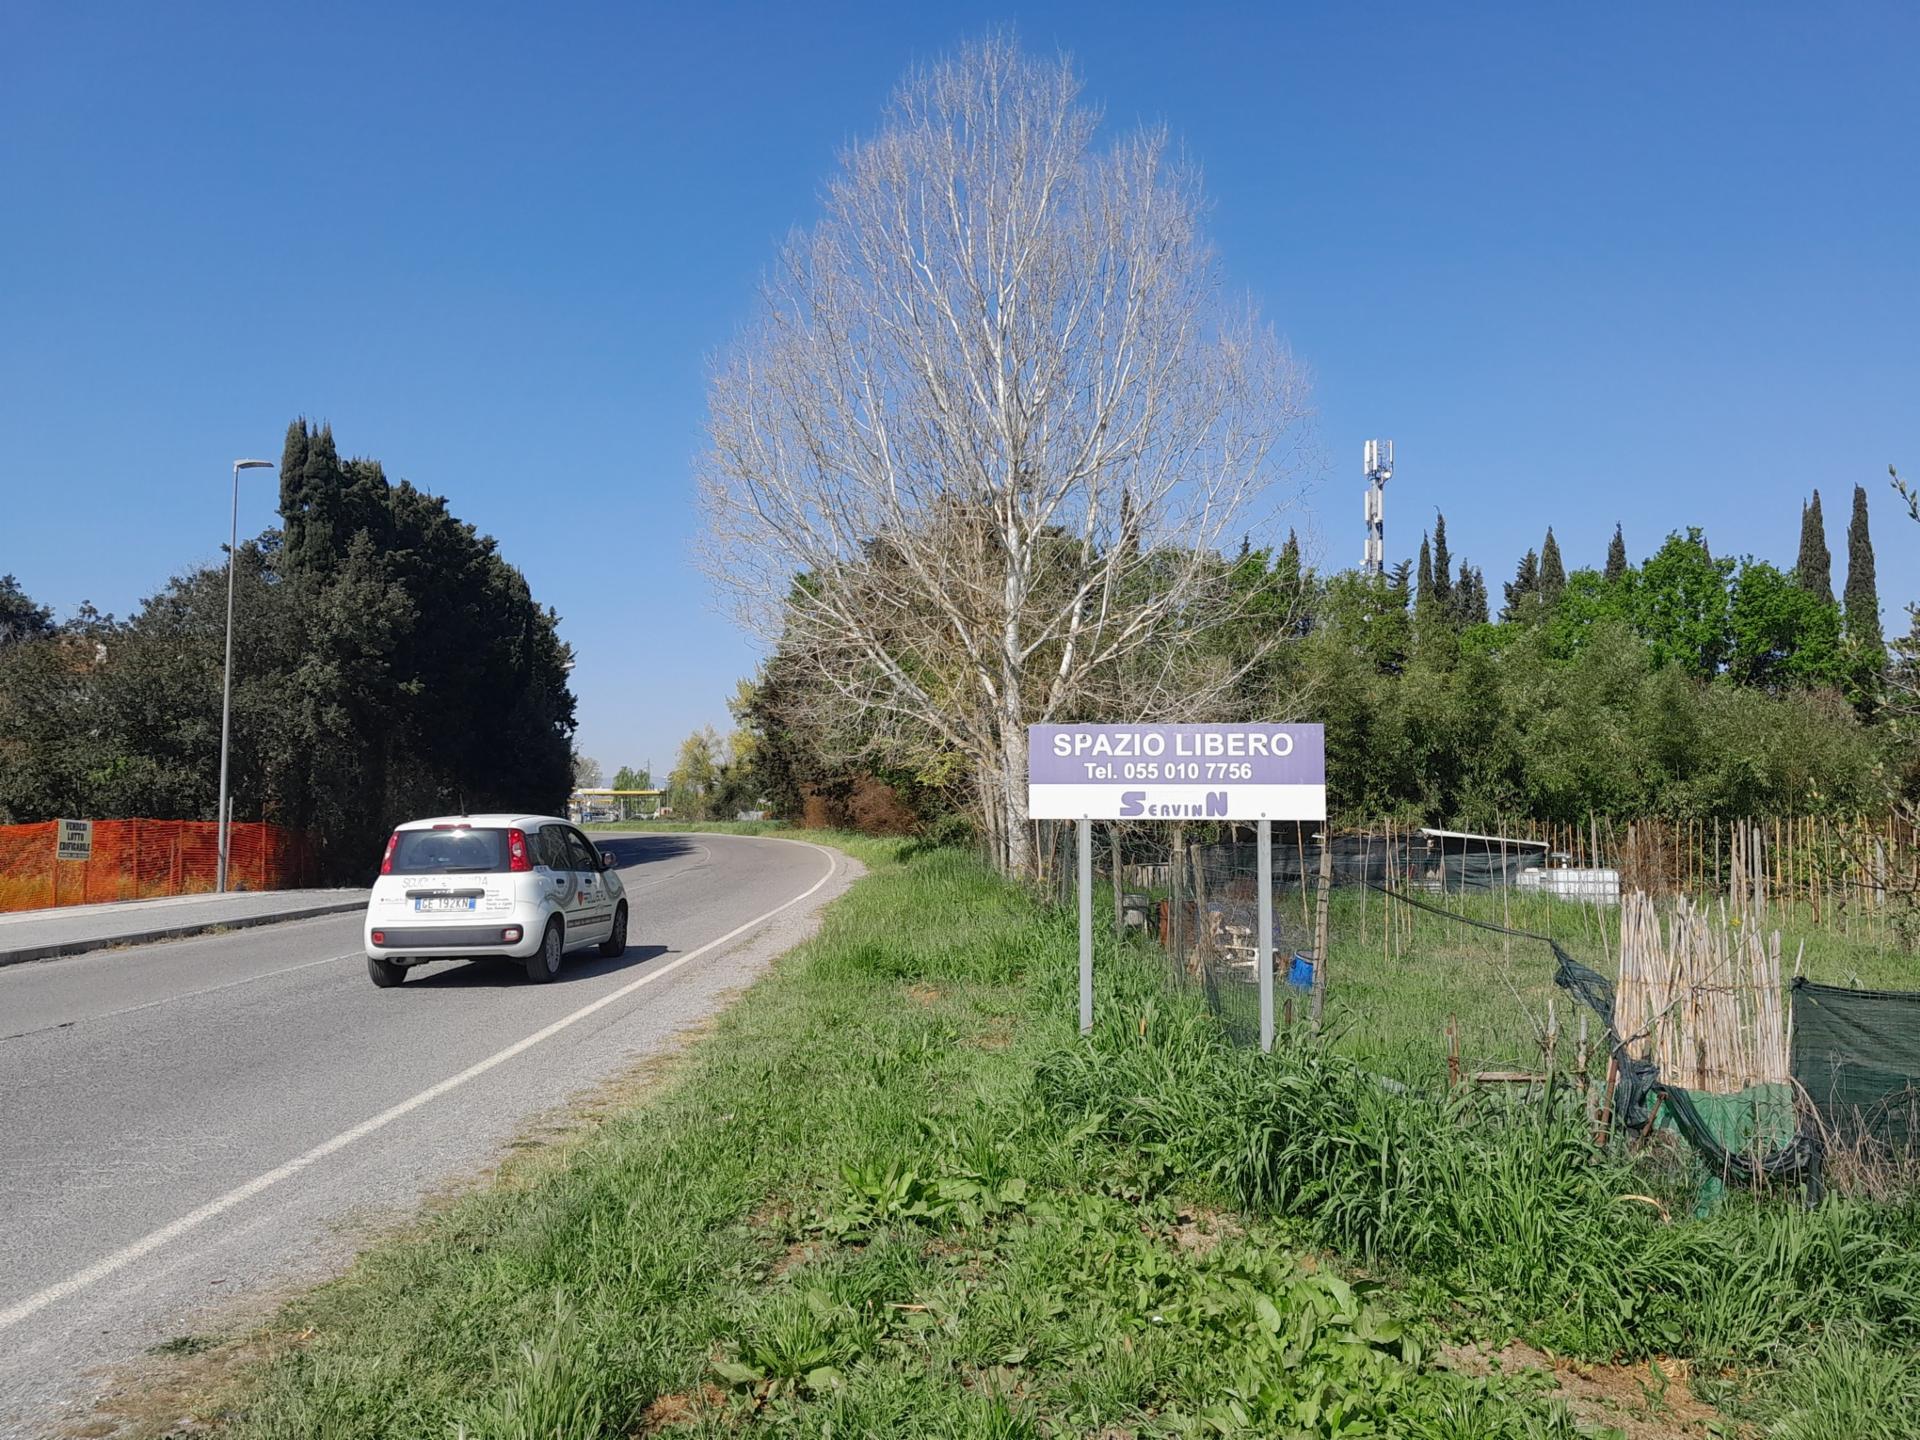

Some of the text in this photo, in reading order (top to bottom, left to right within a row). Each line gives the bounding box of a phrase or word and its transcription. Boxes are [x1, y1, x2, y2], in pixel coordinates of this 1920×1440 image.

[1053, 733, 1294, 757] SPAZIO LIBERO
[1084, 763, 1252, 779] Tel. 055 010 7756
[68, 832, 84, 841] LOTTO
